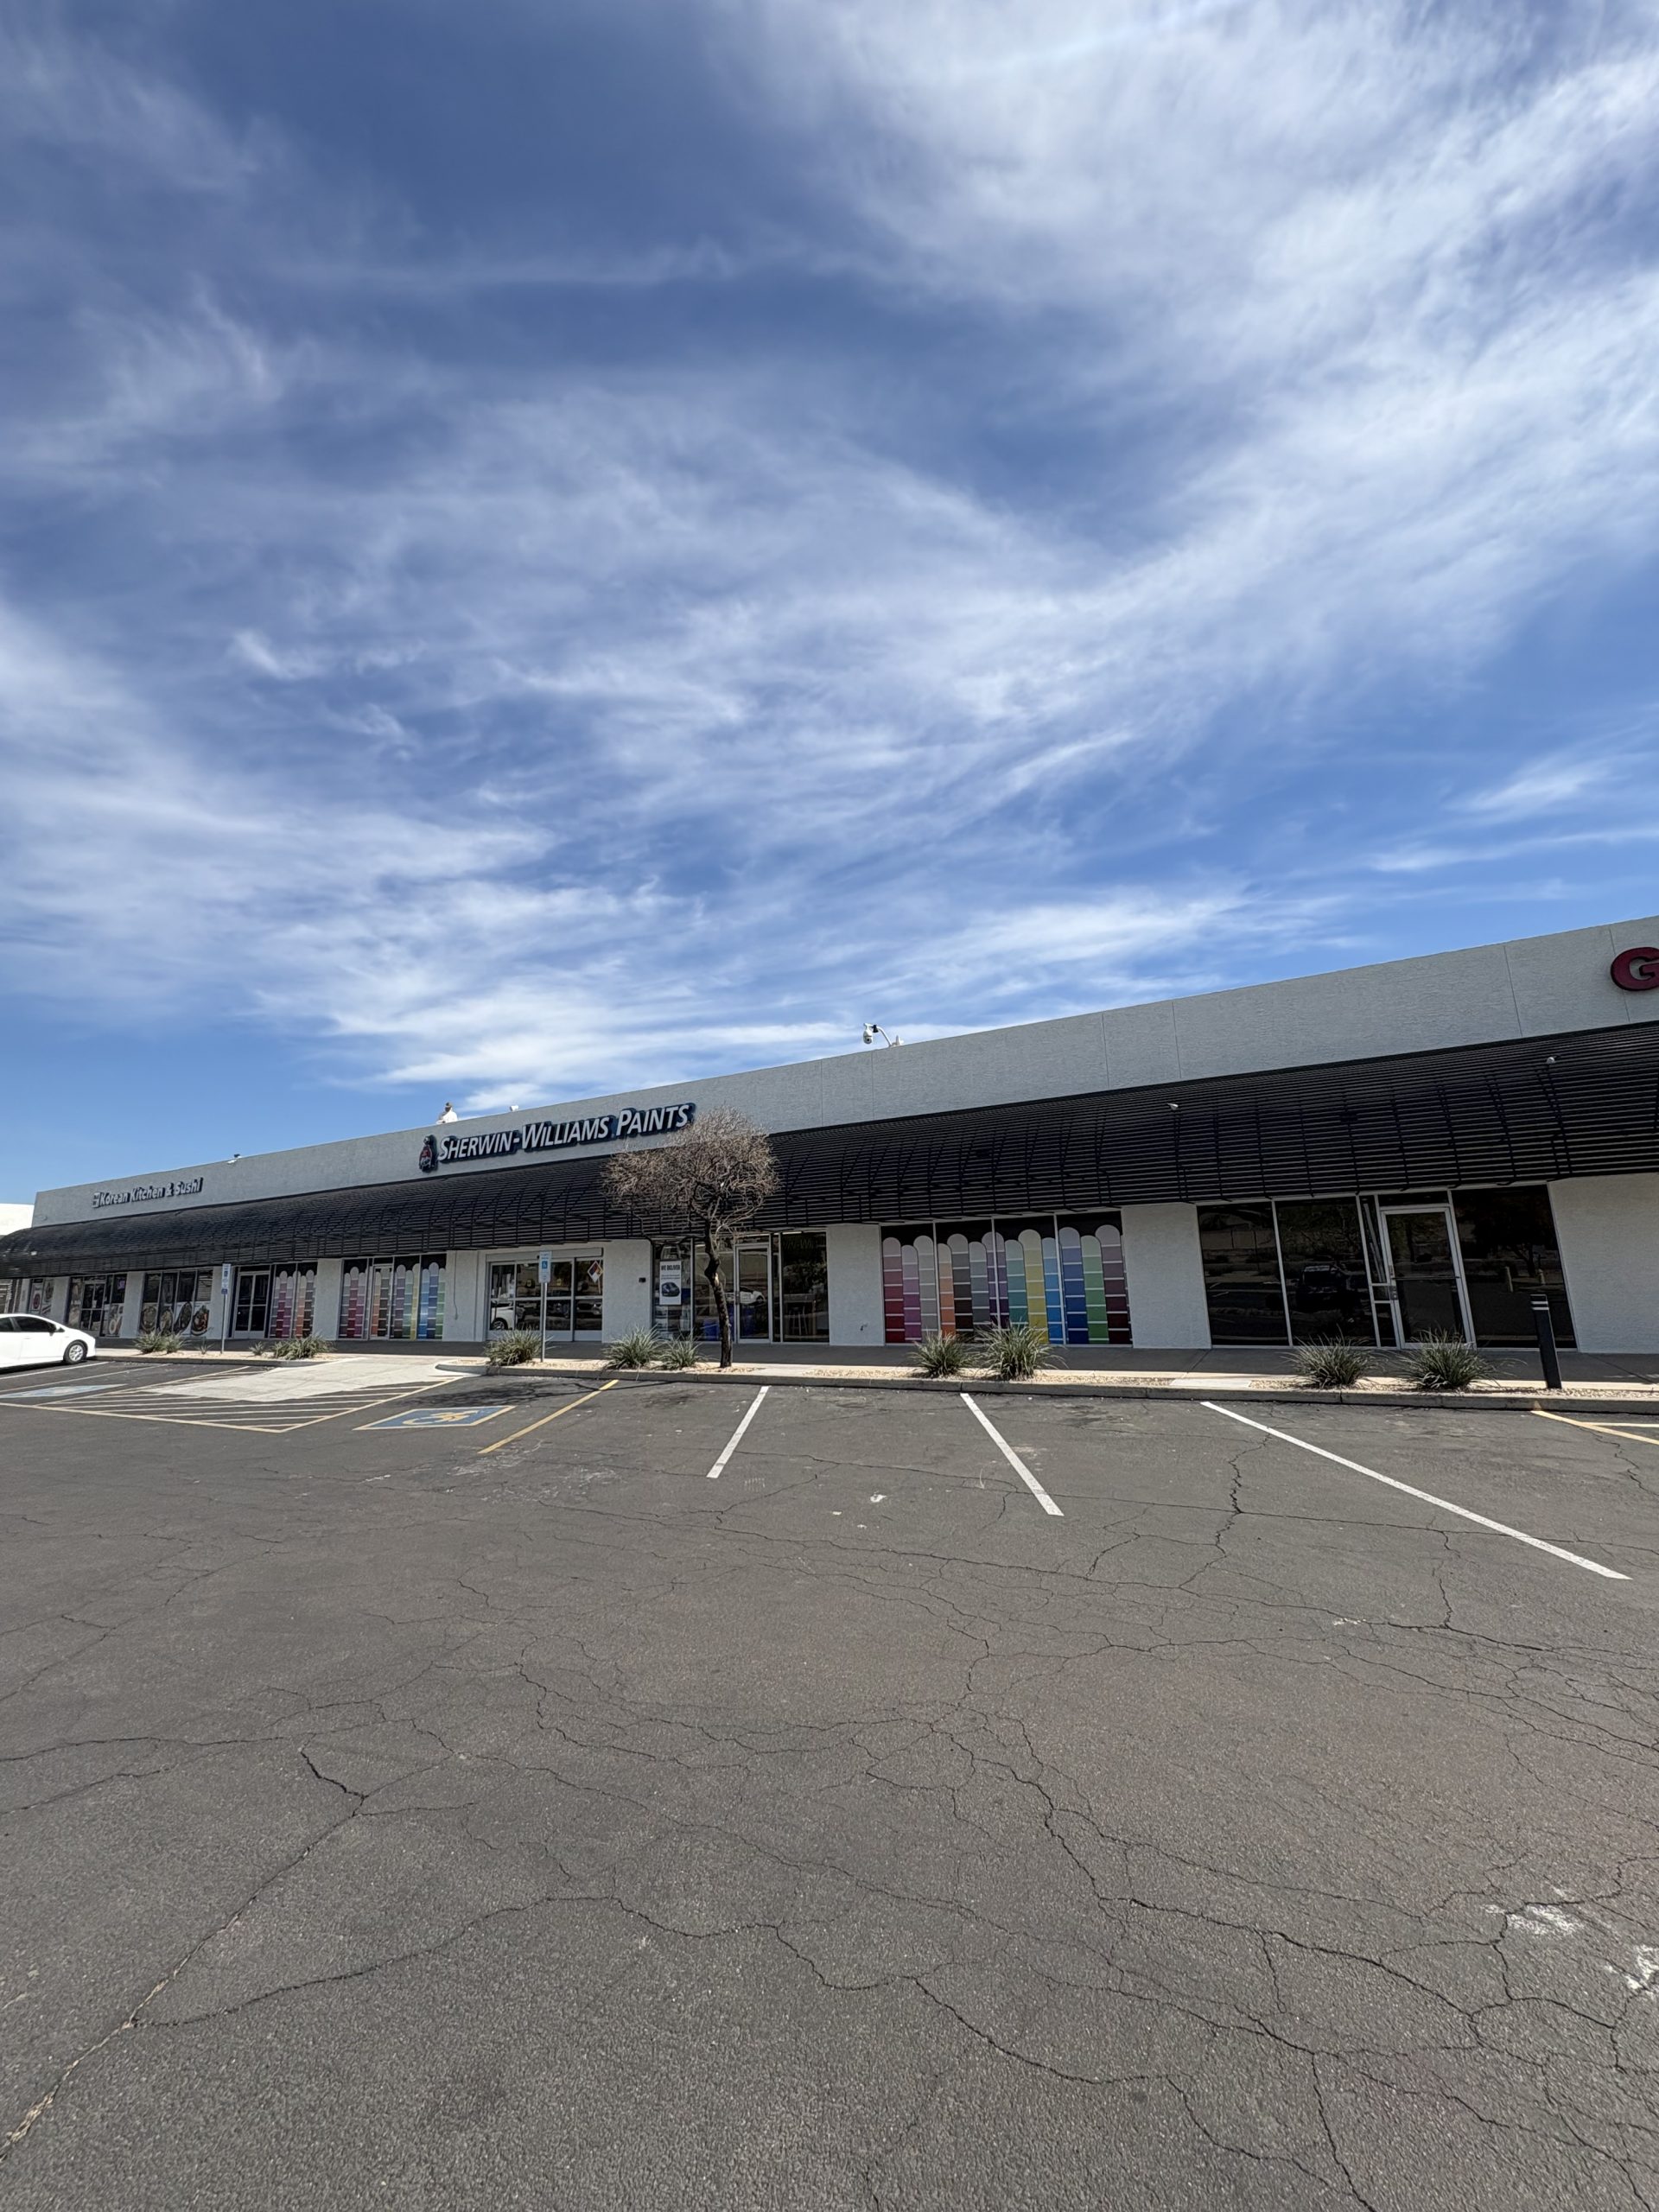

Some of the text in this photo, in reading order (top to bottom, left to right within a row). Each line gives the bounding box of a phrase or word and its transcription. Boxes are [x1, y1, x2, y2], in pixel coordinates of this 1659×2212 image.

[437, 1103, 690, 1161] SHERWIN-WILLIAMS PAINTS
[99, 1192, 130, 1206] Korean
[130, 1185, 164, 1202] Kitchen
[165, 1182, 174, 1197] &
[175, 1178, 203, 1194] Sushi
